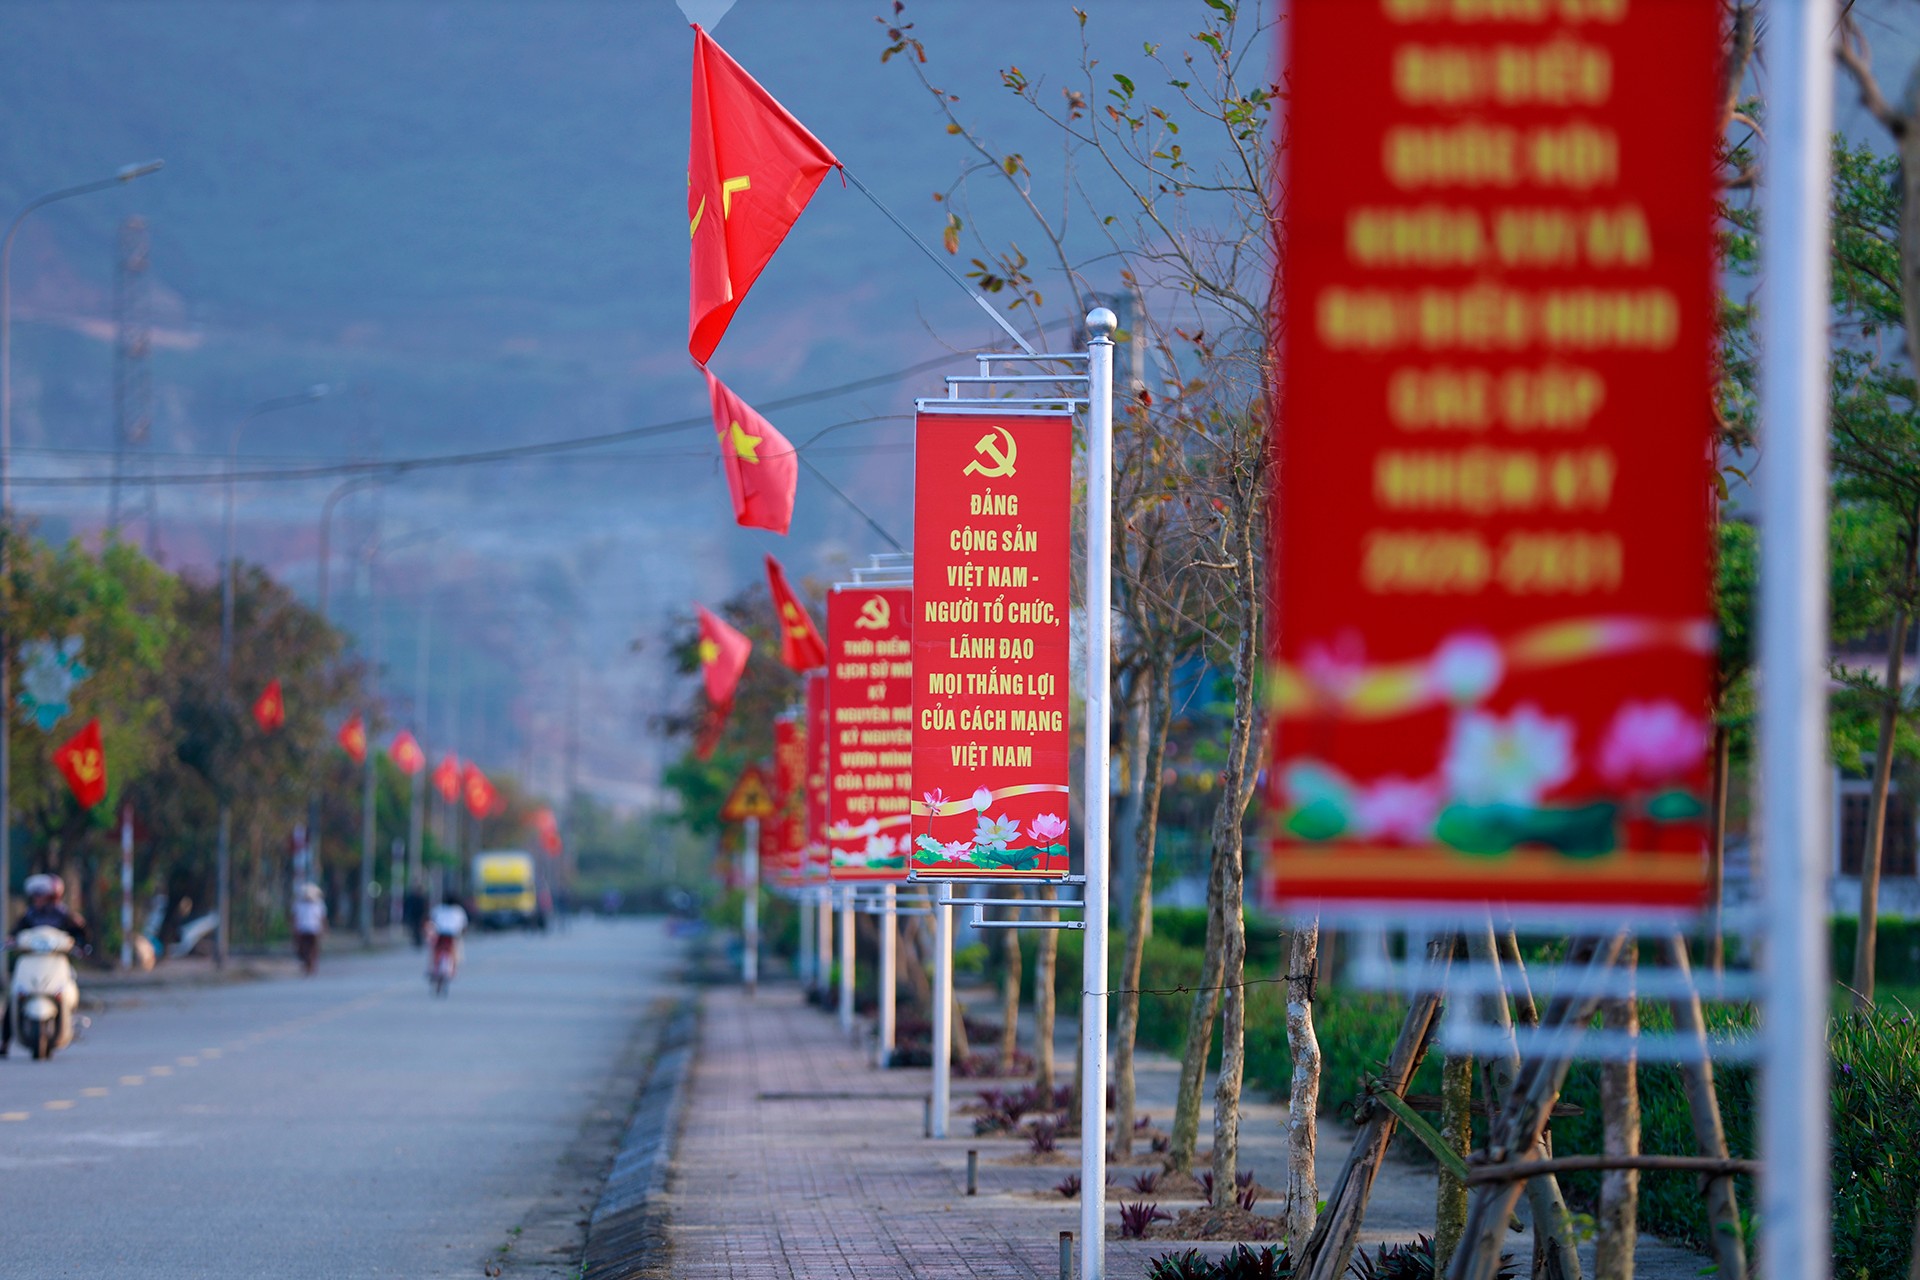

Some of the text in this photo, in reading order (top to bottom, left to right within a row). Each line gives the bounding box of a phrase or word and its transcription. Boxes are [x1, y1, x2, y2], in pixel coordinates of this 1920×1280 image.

[971, 488, 1018, 517] ĐẢNG
[950, 524, 1037, 556] CỘNG SẢN
[947, 562, 984, 591] VIỆT
[988, 566, 1027, 588] NAM
[925, 593, 1060, 627] NGƯỜI TỔ CHỨC,
[950, 633, 1034, 664] LÃNH ĐẠO
[929, 666, 1054, 700] MỌI THẮNG LỢI
[921, 703, 1062, 737] CỦA CÁCH MẠNG
[951, 741, 1032, 771] VIỆT NAM
